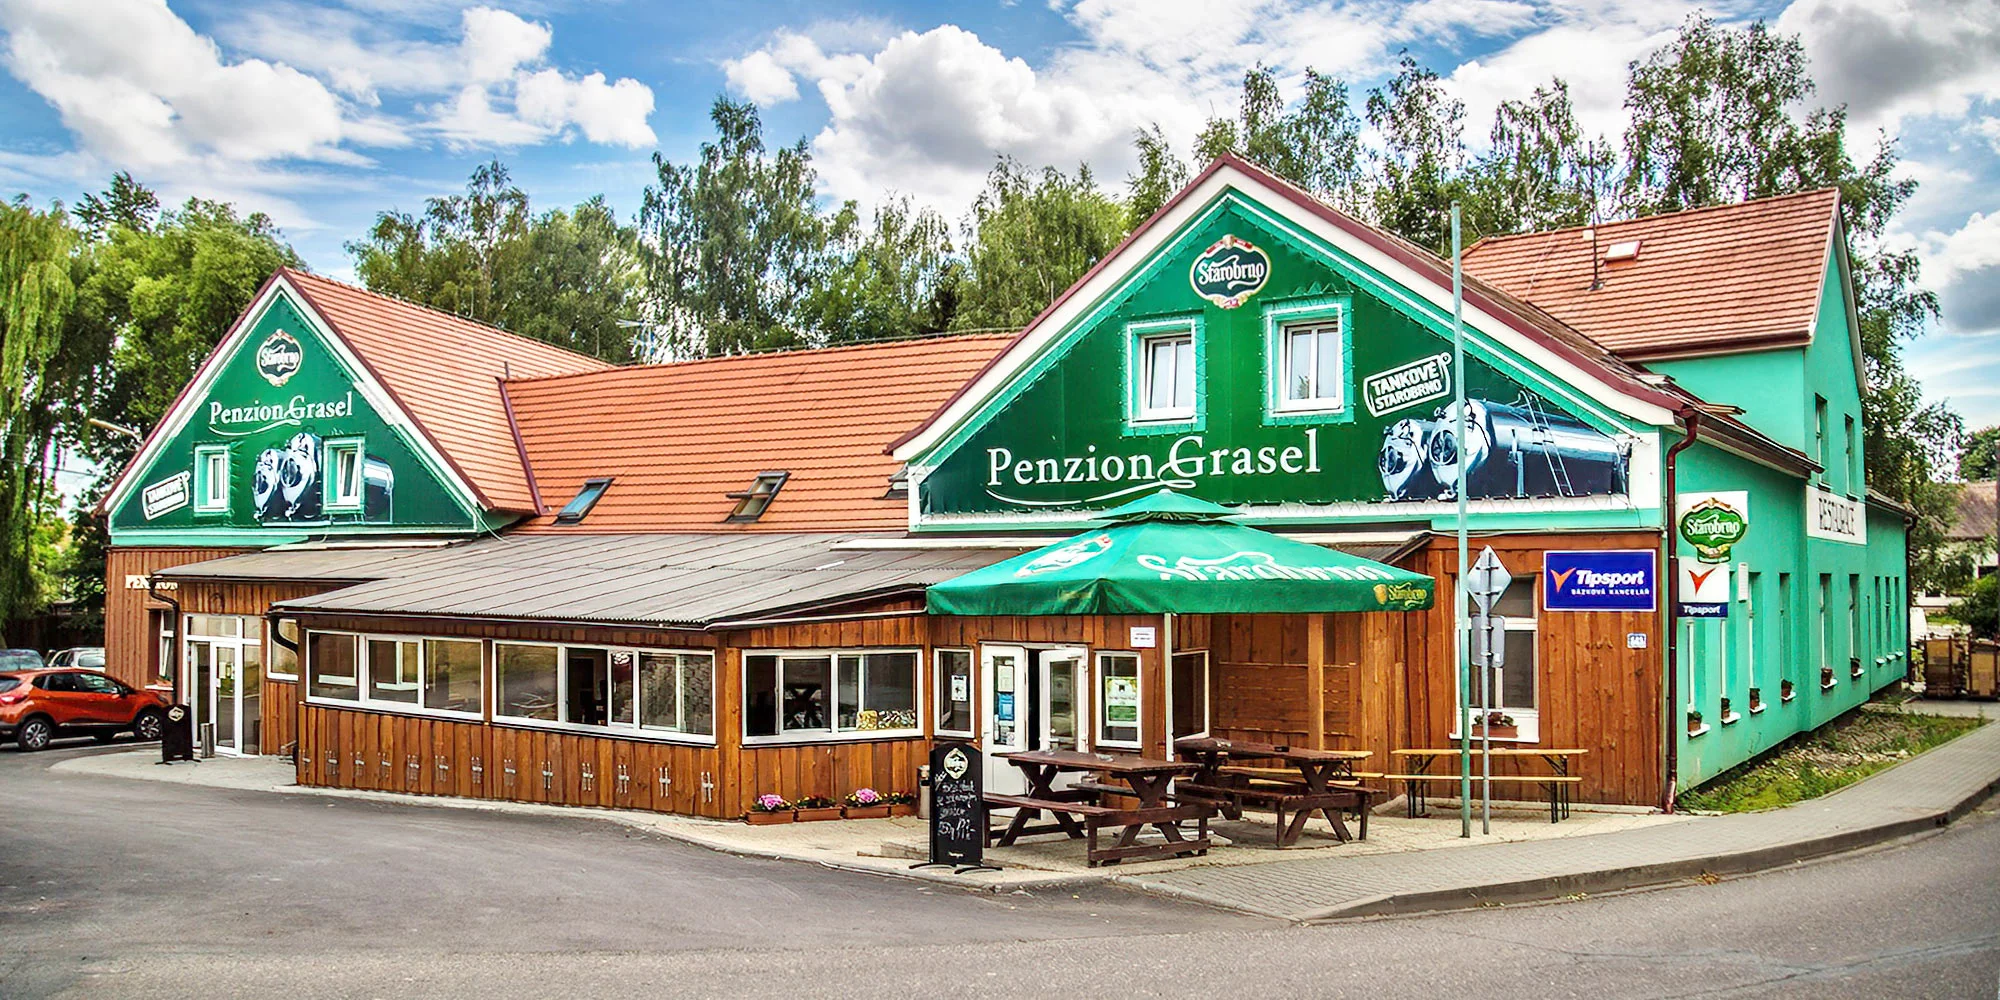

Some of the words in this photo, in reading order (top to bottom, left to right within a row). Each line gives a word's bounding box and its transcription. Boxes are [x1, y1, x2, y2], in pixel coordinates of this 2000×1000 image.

[1198, 255, 1265, 290] Starobrno
[209, 400, 284, 425] Penzion
[284, 391, 353, 422] Grasel
[1374, 379, 1443, 410] STAROBRNO
[987, 445, 1155, 487] Penzion
[1157, 428, 1321, 482] Grasel
[1686, 514, 1741, 541] Starobrno
[1576, 569, 1645, 588] Tipsport
[1683, 604, 1721, 614] Tipsport
